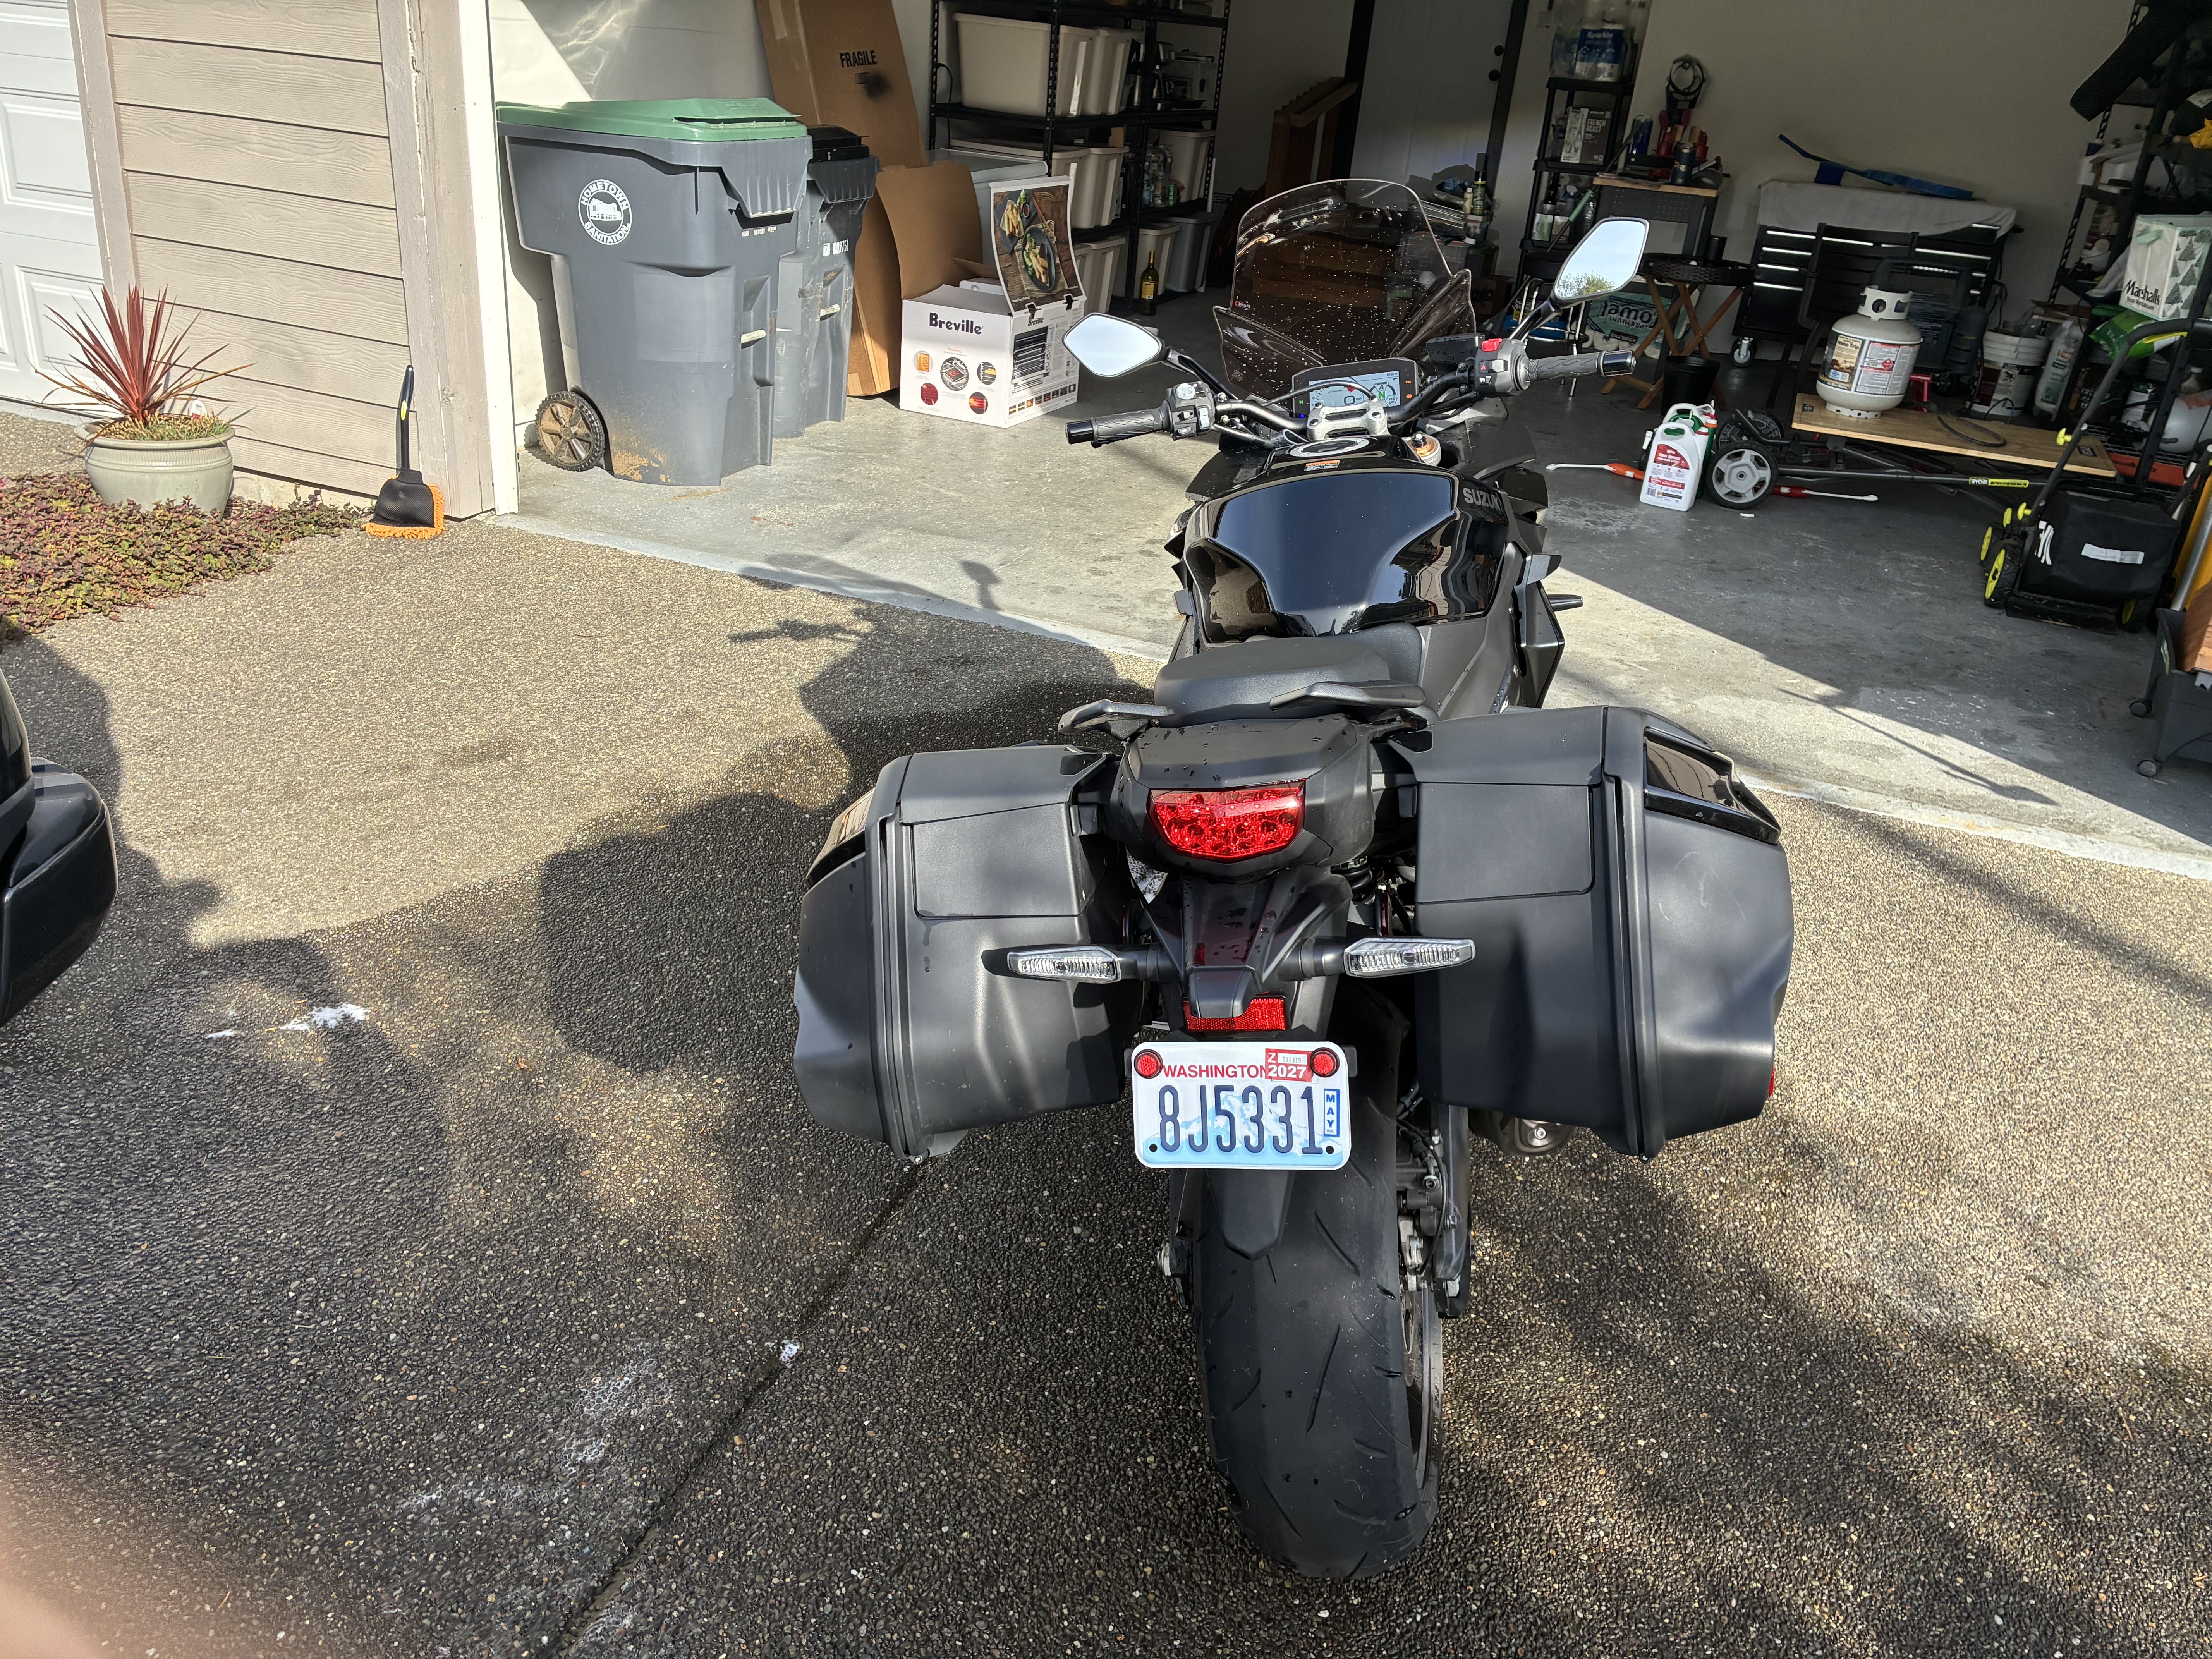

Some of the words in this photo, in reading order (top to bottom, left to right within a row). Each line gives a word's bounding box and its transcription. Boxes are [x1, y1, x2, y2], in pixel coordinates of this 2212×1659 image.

[839, 50, 877, 67] FRAGILE
[581, 182, 629, 210] HOMETOWN
[585, 221, 629, 243] SANITATION
[2123, 279, 2160, 305] Marshalls
[929, 312, 982, 335] Breville
[1463, 488, 1501, 513] SUZUK
[1267, 1053, 1276, 1063] Z
[1163, 1064, 1266, 1078] WASHINGTON
[1268, 1065, 1307, 1079] 2027
[1159, 1085, 1323, 1154] 8J5331
[1326, 1094, 1335, 1128] MAY
